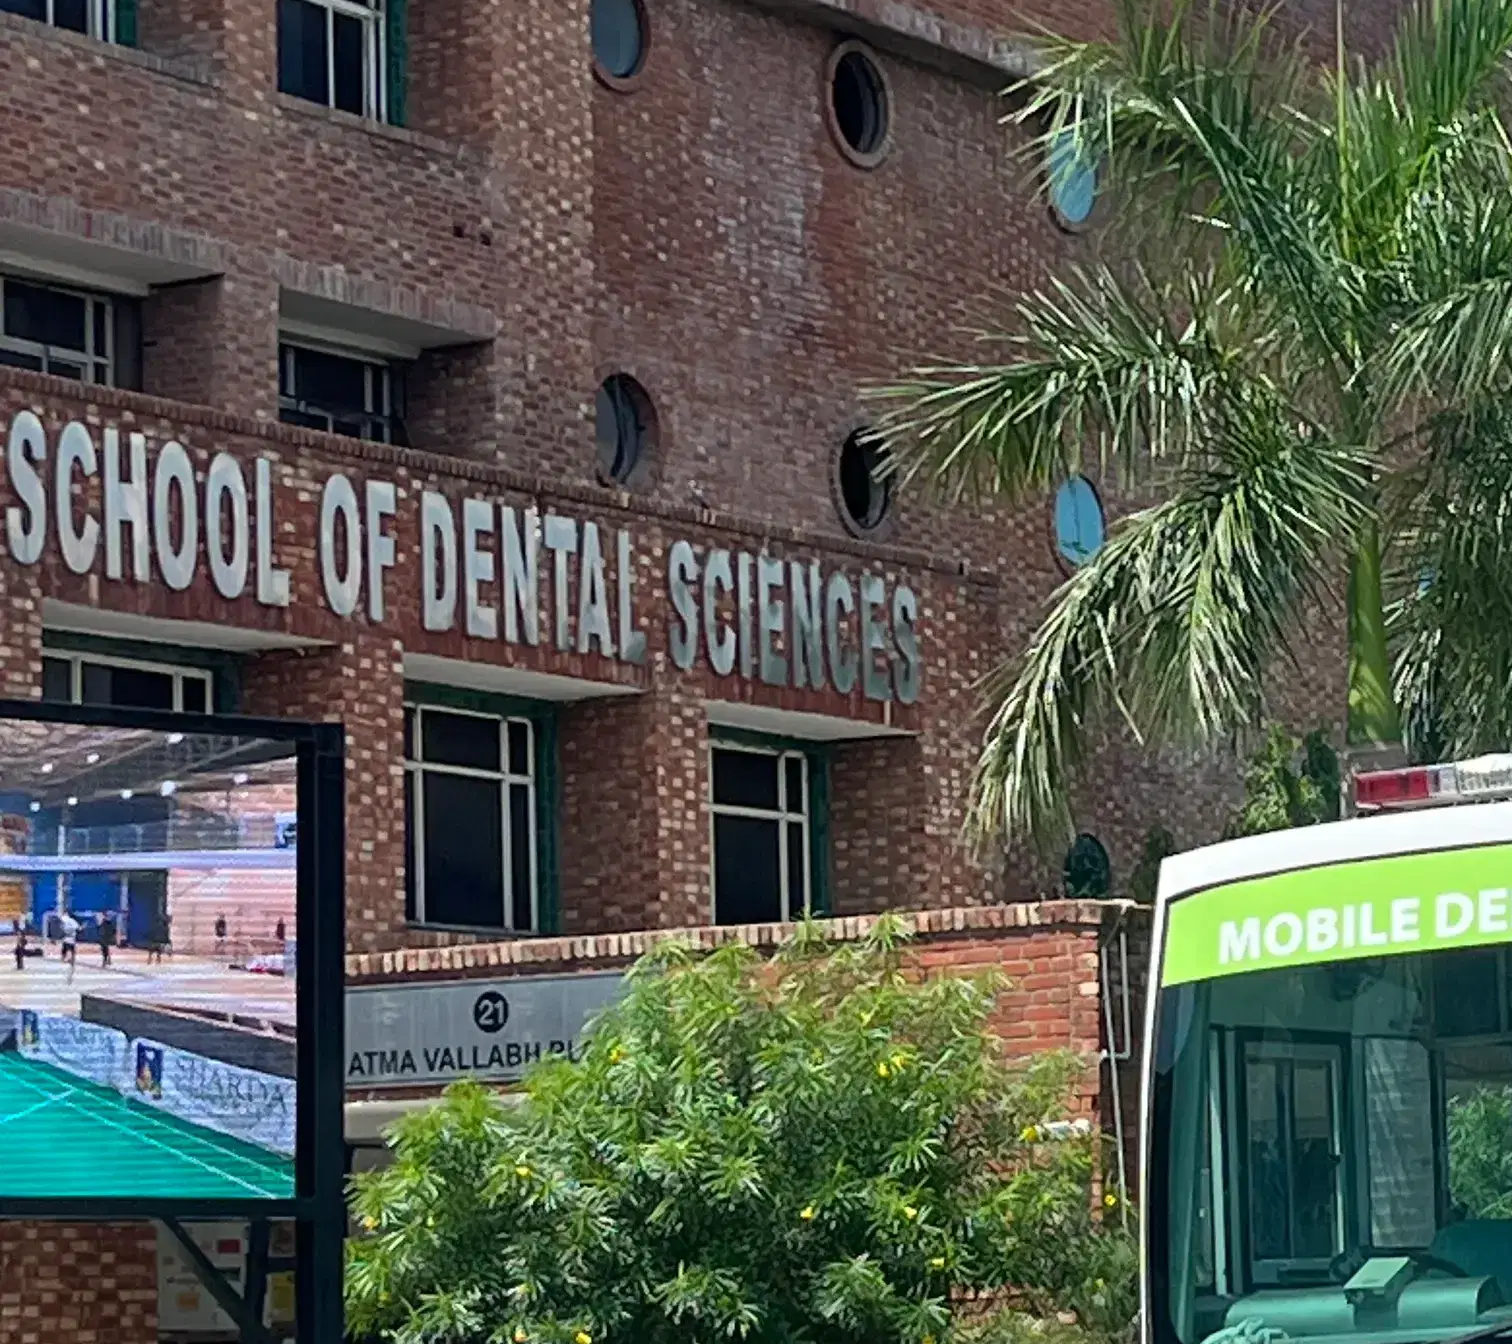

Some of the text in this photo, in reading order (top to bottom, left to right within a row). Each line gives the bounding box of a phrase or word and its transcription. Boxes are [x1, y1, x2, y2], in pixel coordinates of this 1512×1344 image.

[6, 409, 919, 705] SCHOOL OF DENTAL SCIENCES
[1218, 897, 1421, 964] MOBILE
[478, 999, 506, 1026] 21
[349, 1050, 417, 1077] ATMA
[423, 1042, 541, 1072] VALLABH
